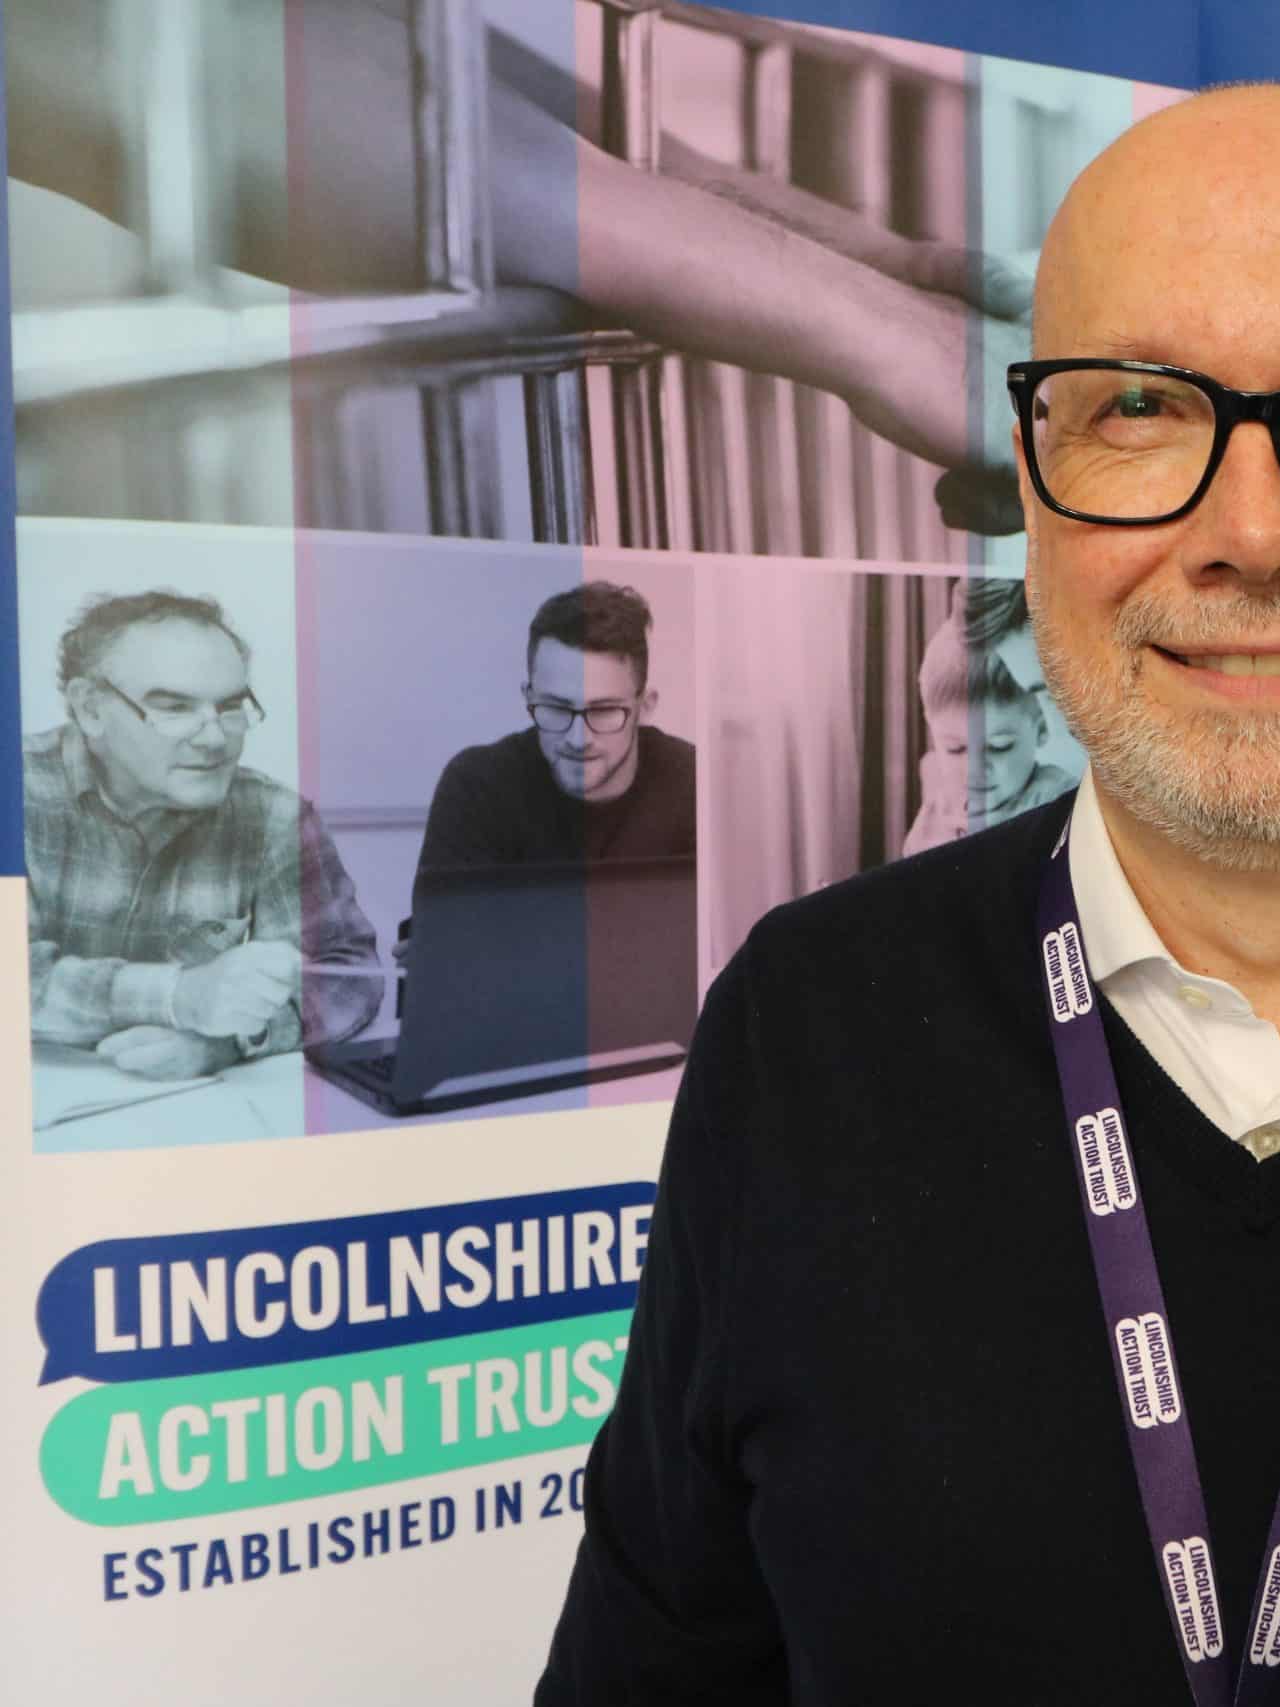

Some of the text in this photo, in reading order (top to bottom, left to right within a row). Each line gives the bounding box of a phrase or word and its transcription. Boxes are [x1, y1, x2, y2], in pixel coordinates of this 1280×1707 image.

[1046, 939, 1070, 1015] ACTION TRUST
[1063, 928, 1089, 1008] LINCOLNSHIRE
[1080, 1124, 1109, 1207] ACTION TRUST
[1102, 1114, 1133, 1202] LINCOLNSHIRE
[93, 1204, 655, 1353] LINCOLNSHIRE
[1120, 1328, 1151, 1419] ACTION TRUST
[1144, 1320, 1176, 1415] LINCOLNSHIRE
[98, 1336, 629, 1499] ACTION TRUS
[104, 1495, 456, 1601] ESTABLISHED
[476, 1481, 522, 1533] IN
[1167, 1552, 1200, 1652] ACTION TRUST
[1189, 1545, 1219, 1649] LINCOLNSHIRE
